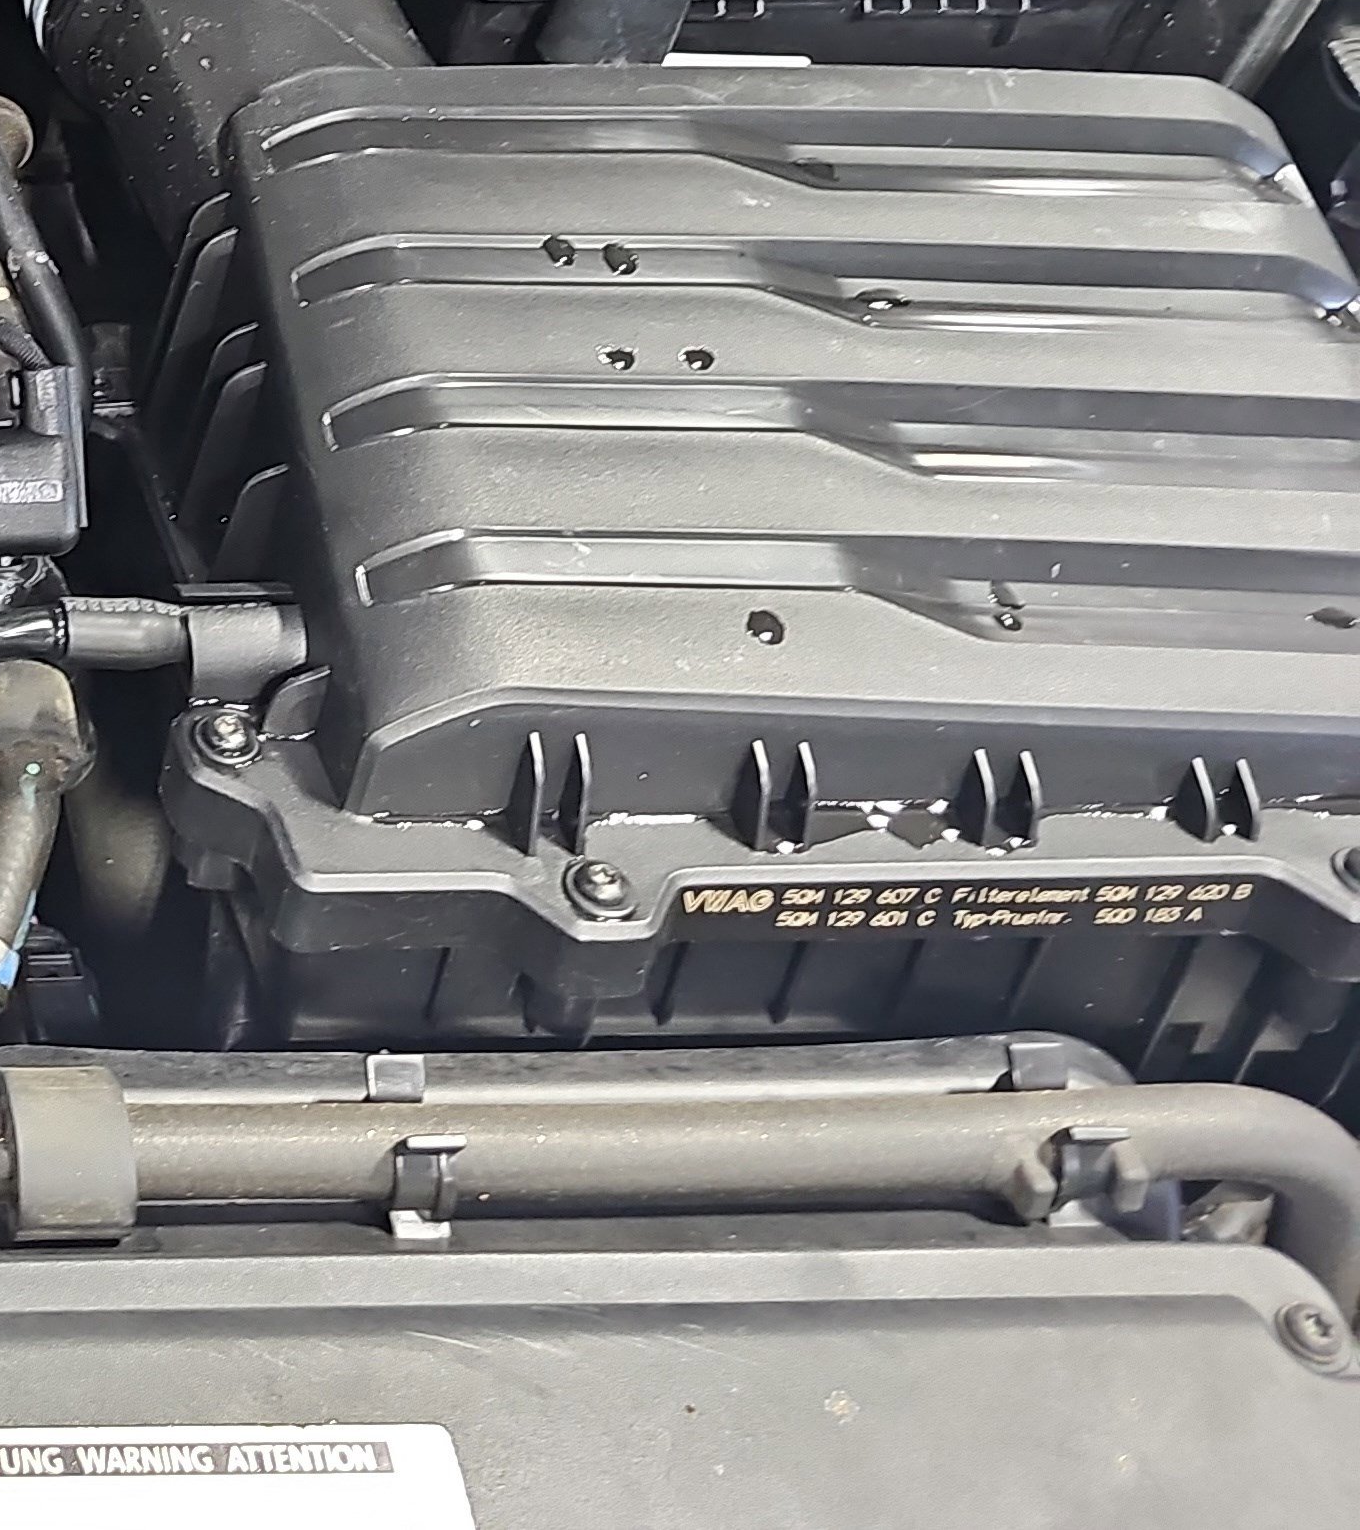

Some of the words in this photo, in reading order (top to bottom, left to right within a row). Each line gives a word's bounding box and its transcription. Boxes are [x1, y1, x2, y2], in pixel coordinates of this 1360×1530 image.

[833, 887, 870, 905] 129
[878, 887, 917, 905] 607
[1145, 884, 1182, 902] 129
[827, 909, 864, 927] 129
[873, 909, 908, 927] 601
[79, 1446, 214, 1475] WARNING
[227, 1444, 377, 1474] ATTENTION
